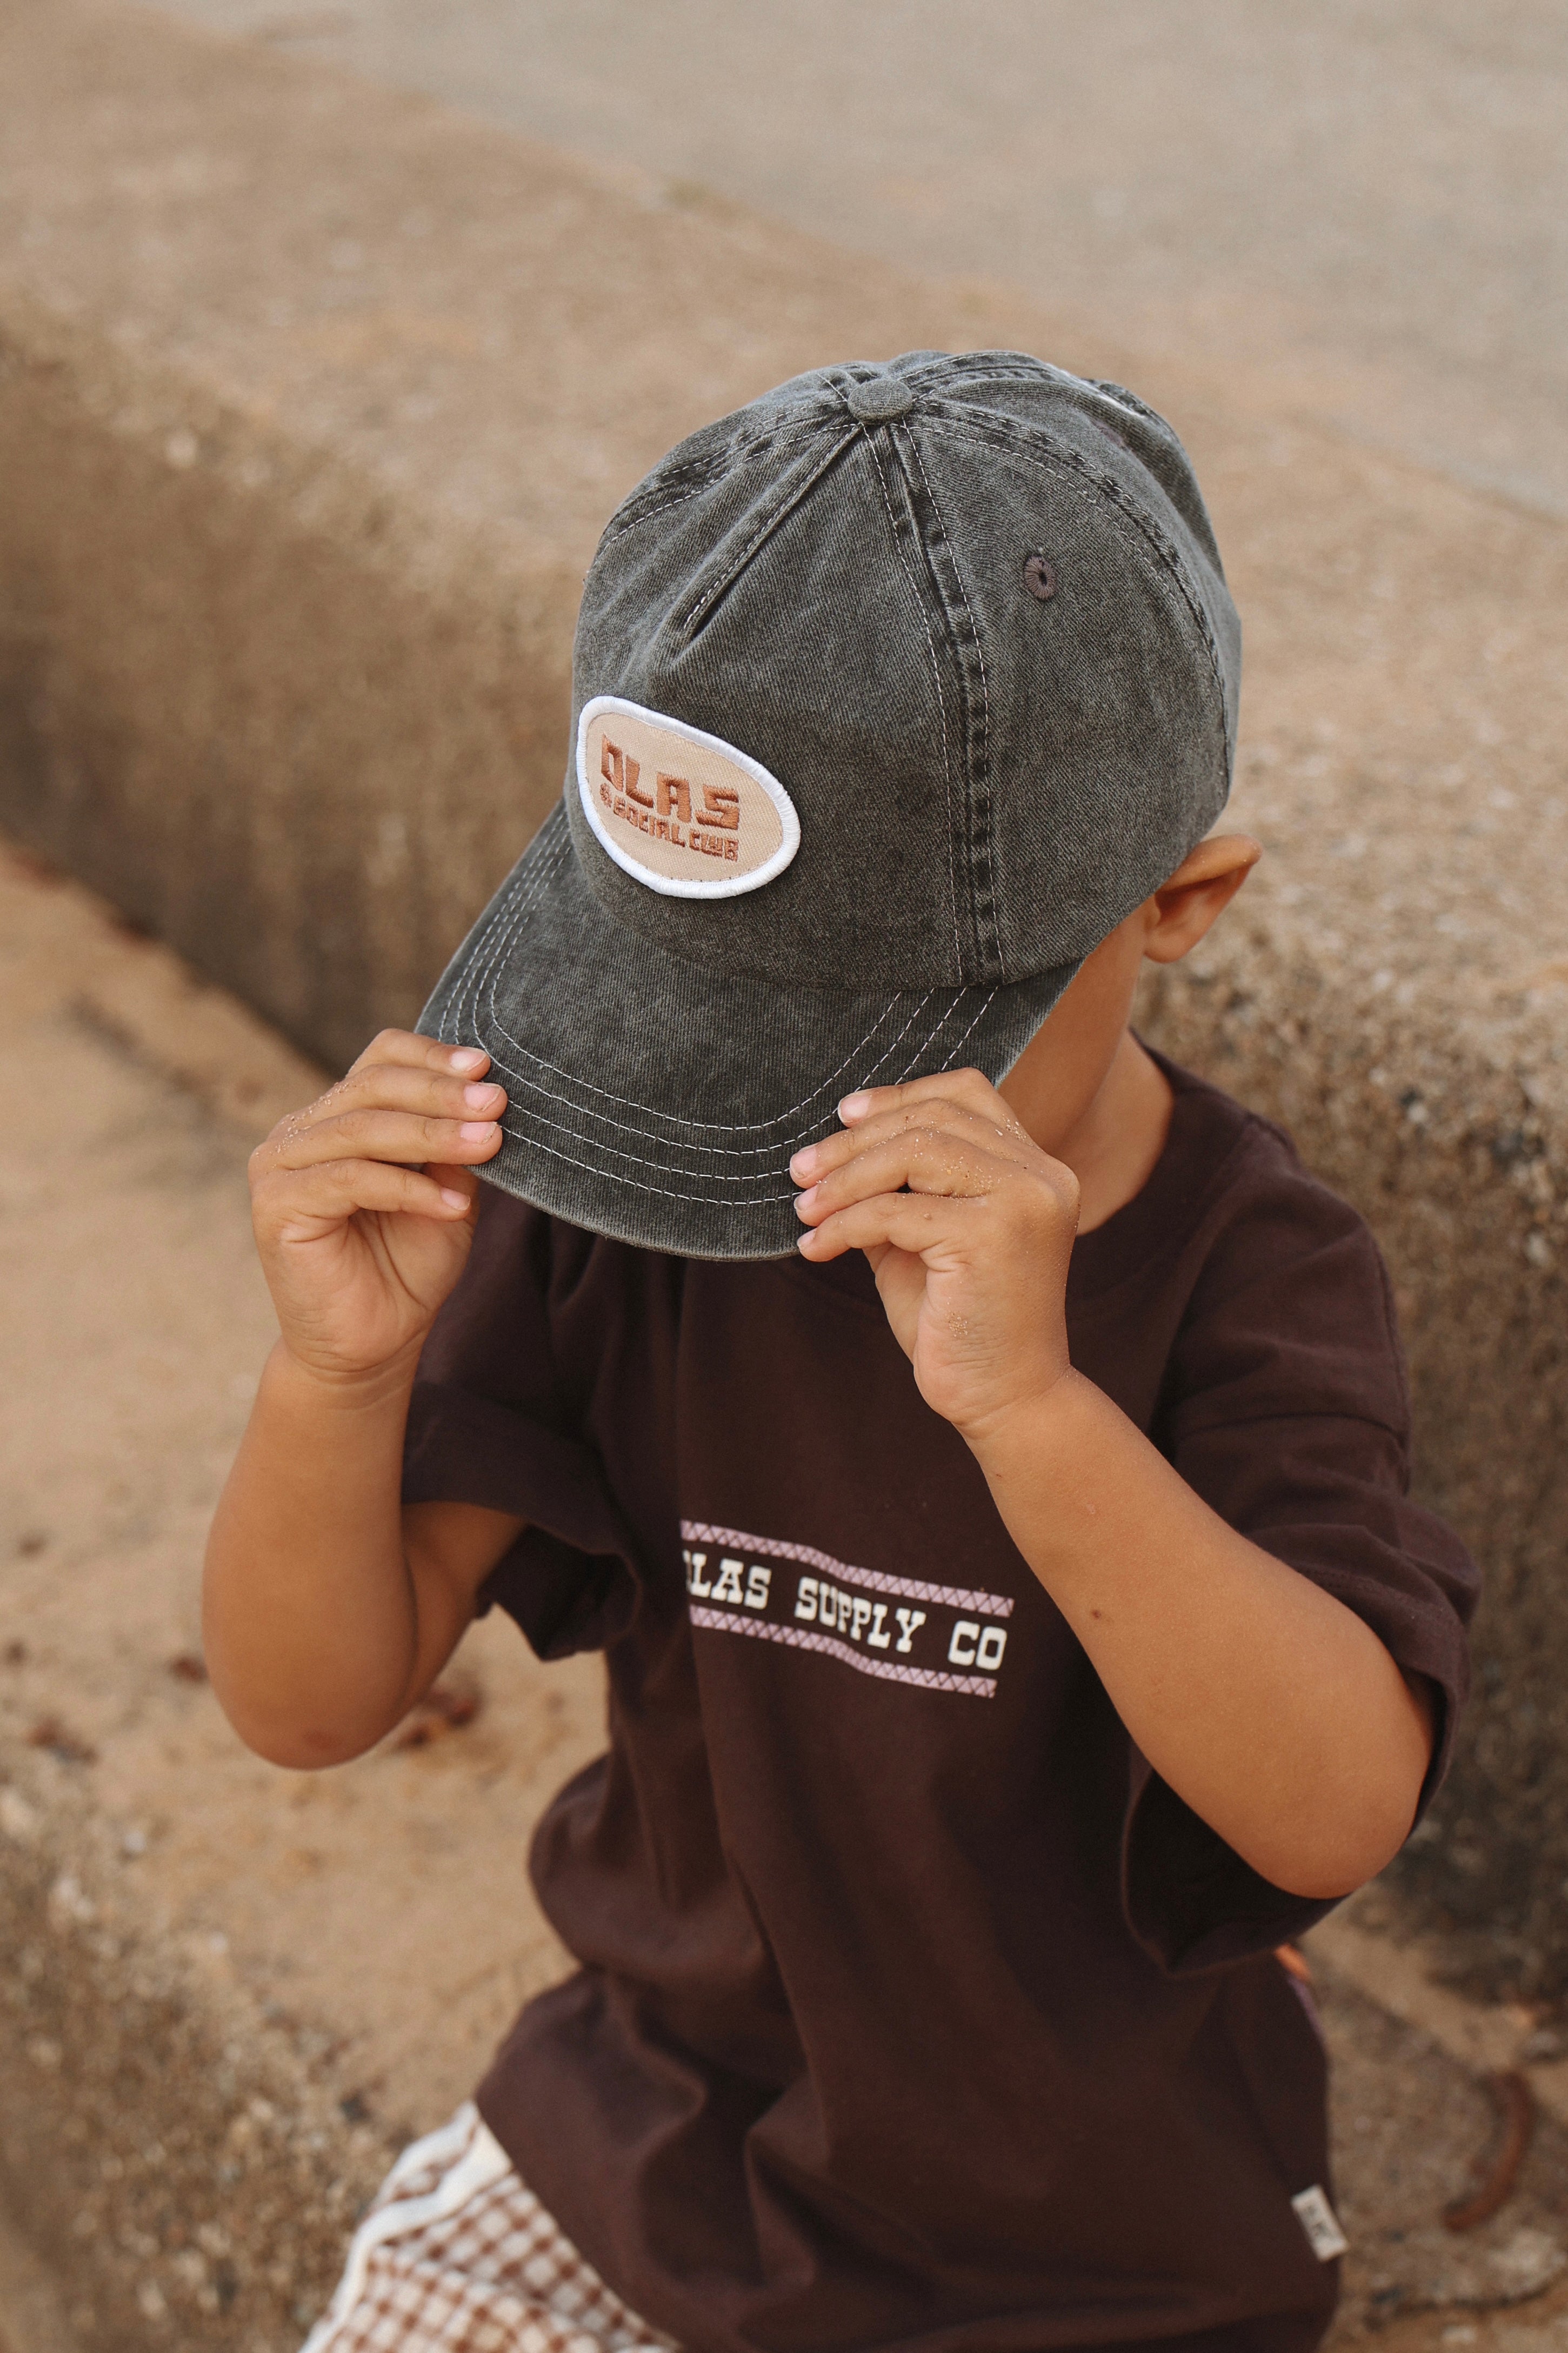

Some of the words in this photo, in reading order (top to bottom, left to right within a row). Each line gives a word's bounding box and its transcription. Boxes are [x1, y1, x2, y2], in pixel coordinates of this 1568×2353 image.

[600, 734, 739, 830] OLAS
[613, 796, 685, 847] SOCIAL
[689, 830, 738, 862] CLUB
[683, 1550, 771, 1609] LAS
[795, 1577, 926, 1653] SUPPLY
[948, 1621, 1007, 1670] CO
